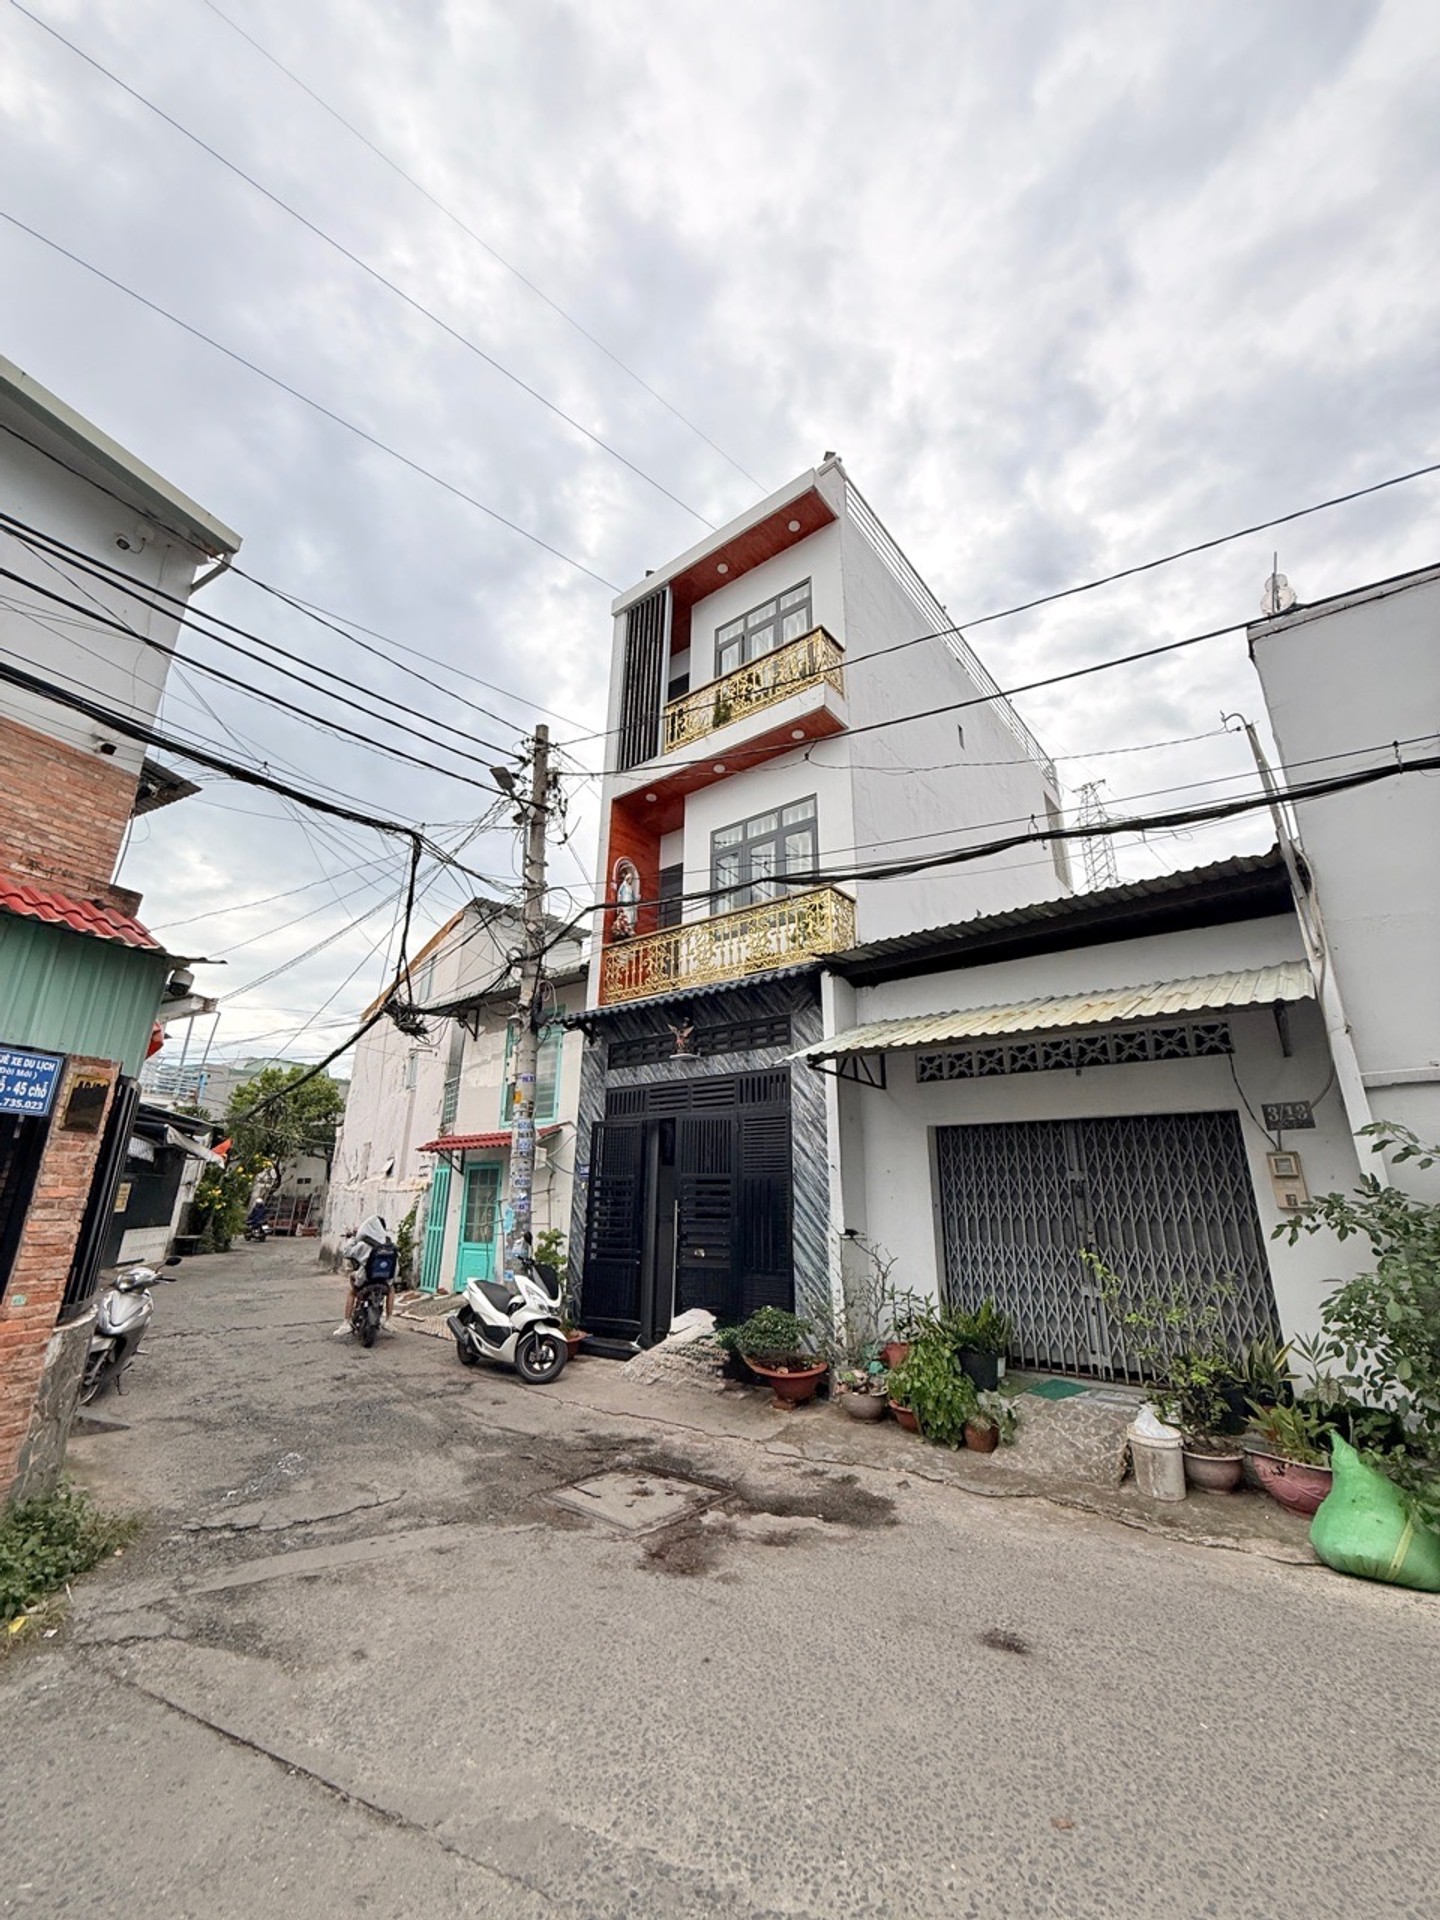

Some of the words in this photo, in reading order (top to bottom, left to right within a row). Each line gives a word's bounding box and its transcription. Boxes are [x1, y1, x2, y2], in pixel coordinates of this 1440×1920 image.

[11, 1056, 23, 1066] XE
[23, 1058, 36, 1068] DU
[36, 1060, 55, 1072] LỊCH
[13, 1081, 28, 1096] 45
[28, 1081, 49, 1098] chỗ
